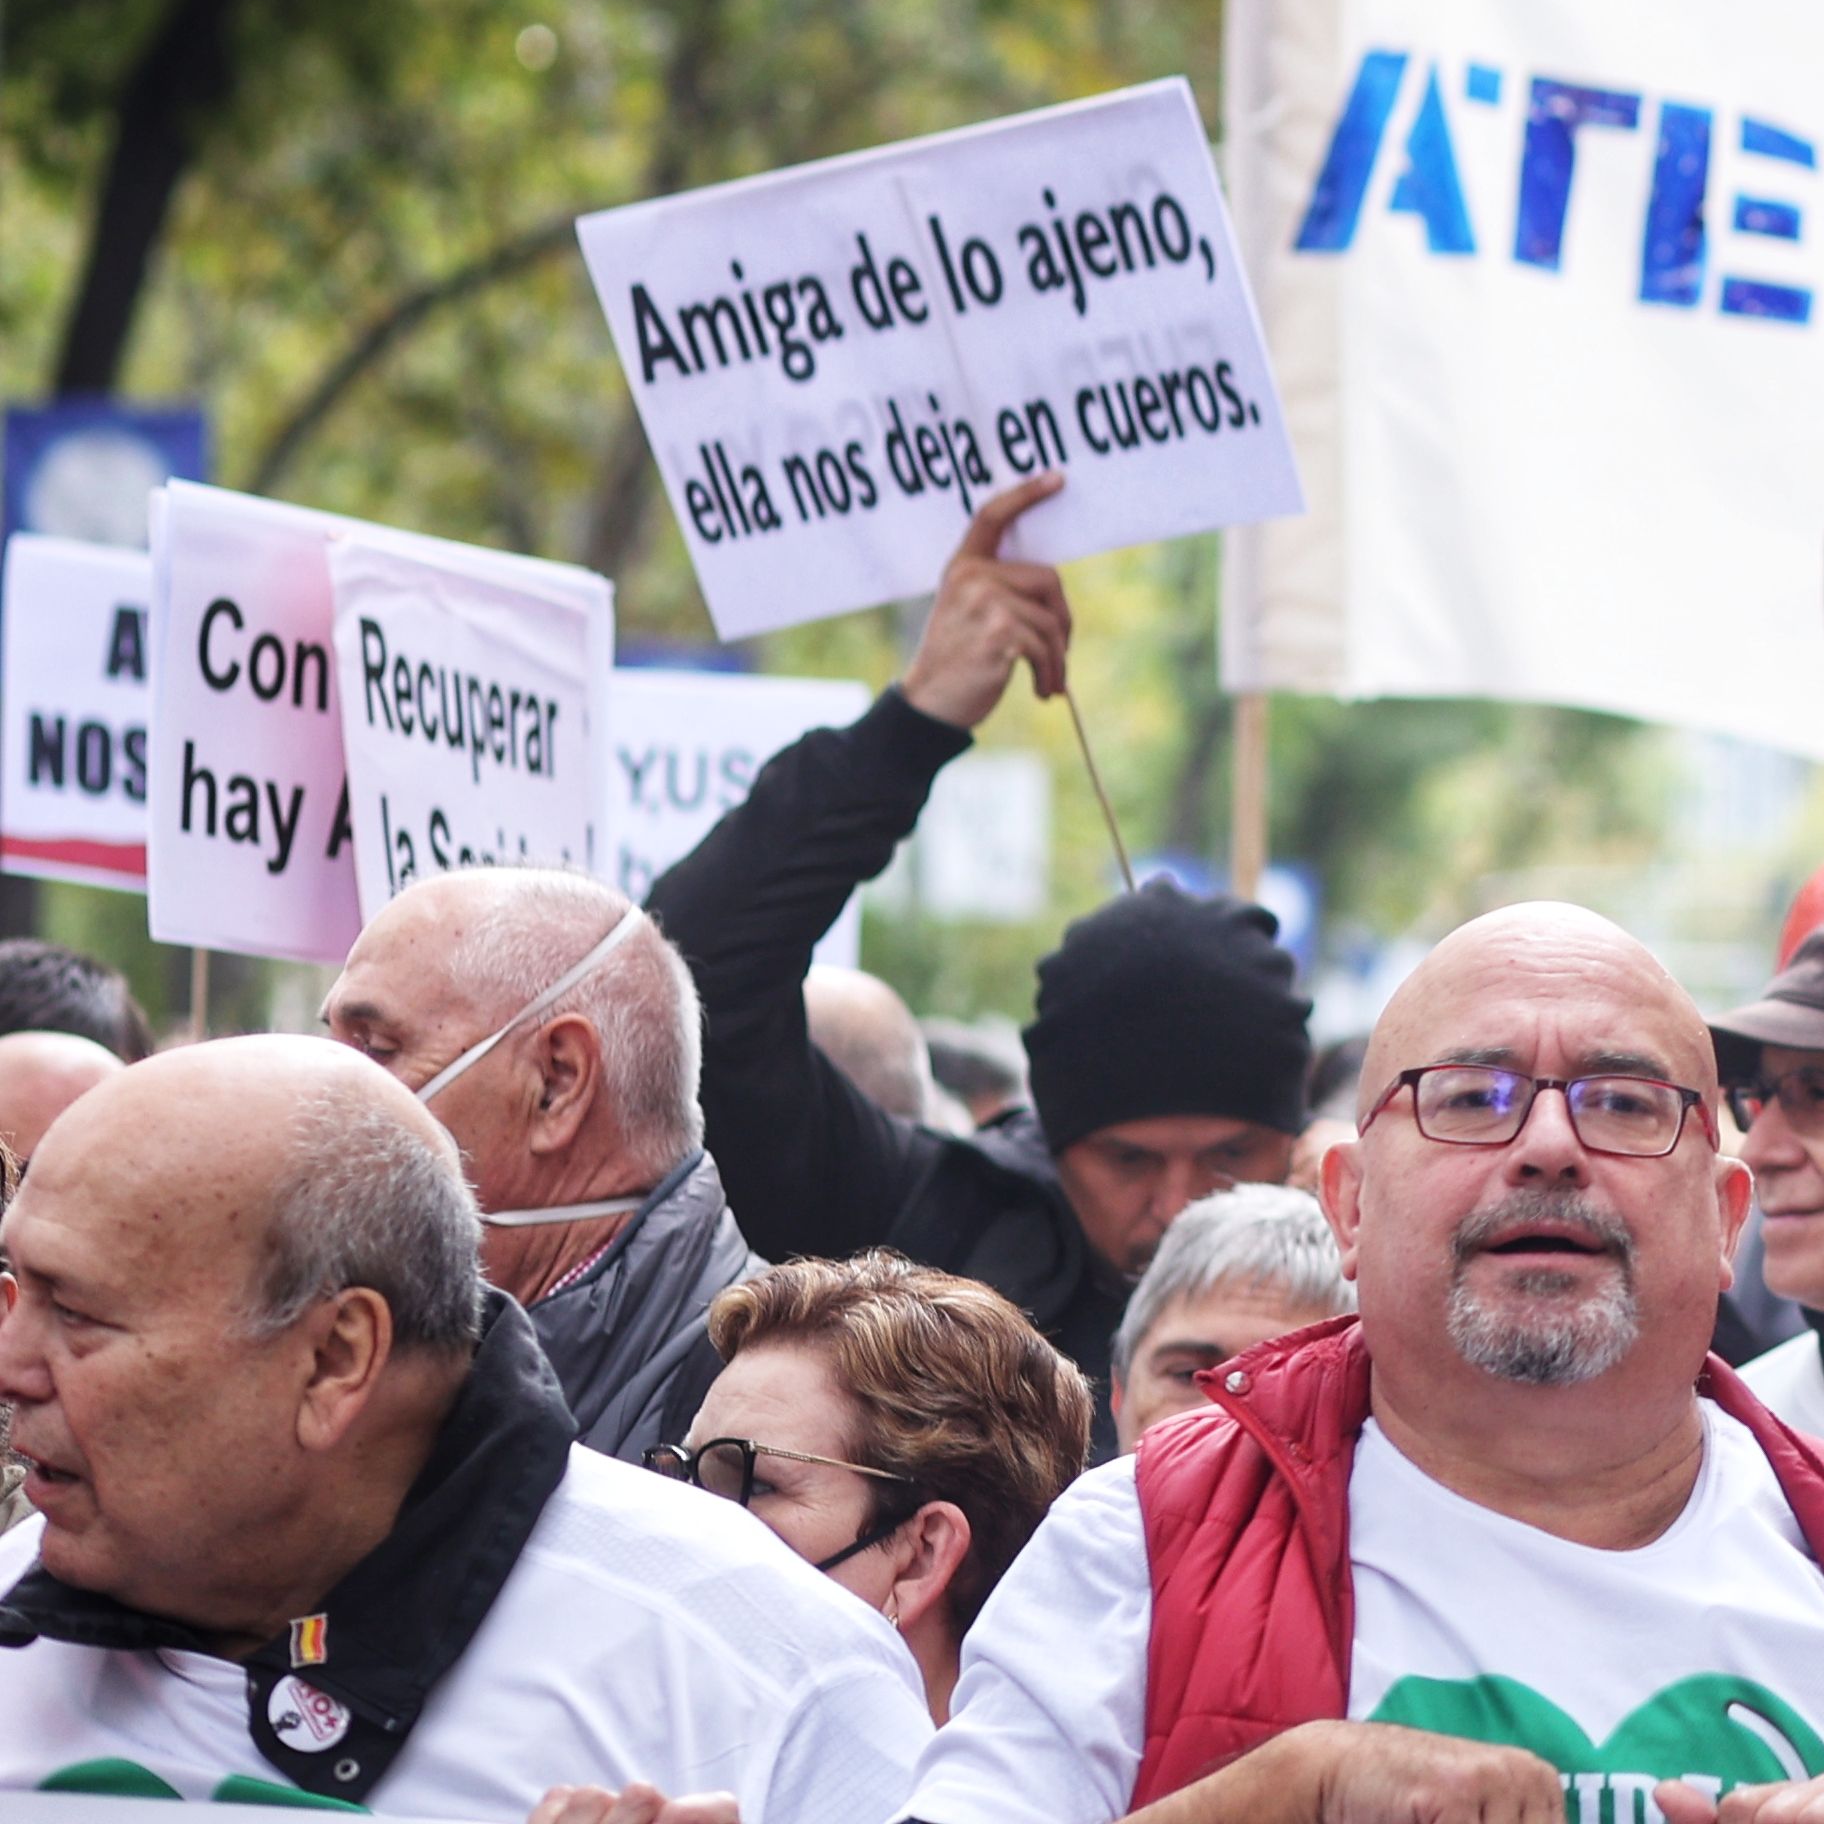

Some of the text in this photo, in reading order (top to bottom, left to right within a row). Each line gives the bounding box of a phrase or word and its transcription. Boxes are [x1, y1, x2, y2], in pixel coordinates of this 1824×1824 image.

[629, 187, 1217, 385] Amiga de lo ajeno,
[685, 358, 1262, 545] ella nos deja en cueros.
[198, 597, 330, 713] Con
[359, 615, 560, 784] Recuperar
[28, 711, 147, 804] NOS
[180, 739, 306, 877] hay
